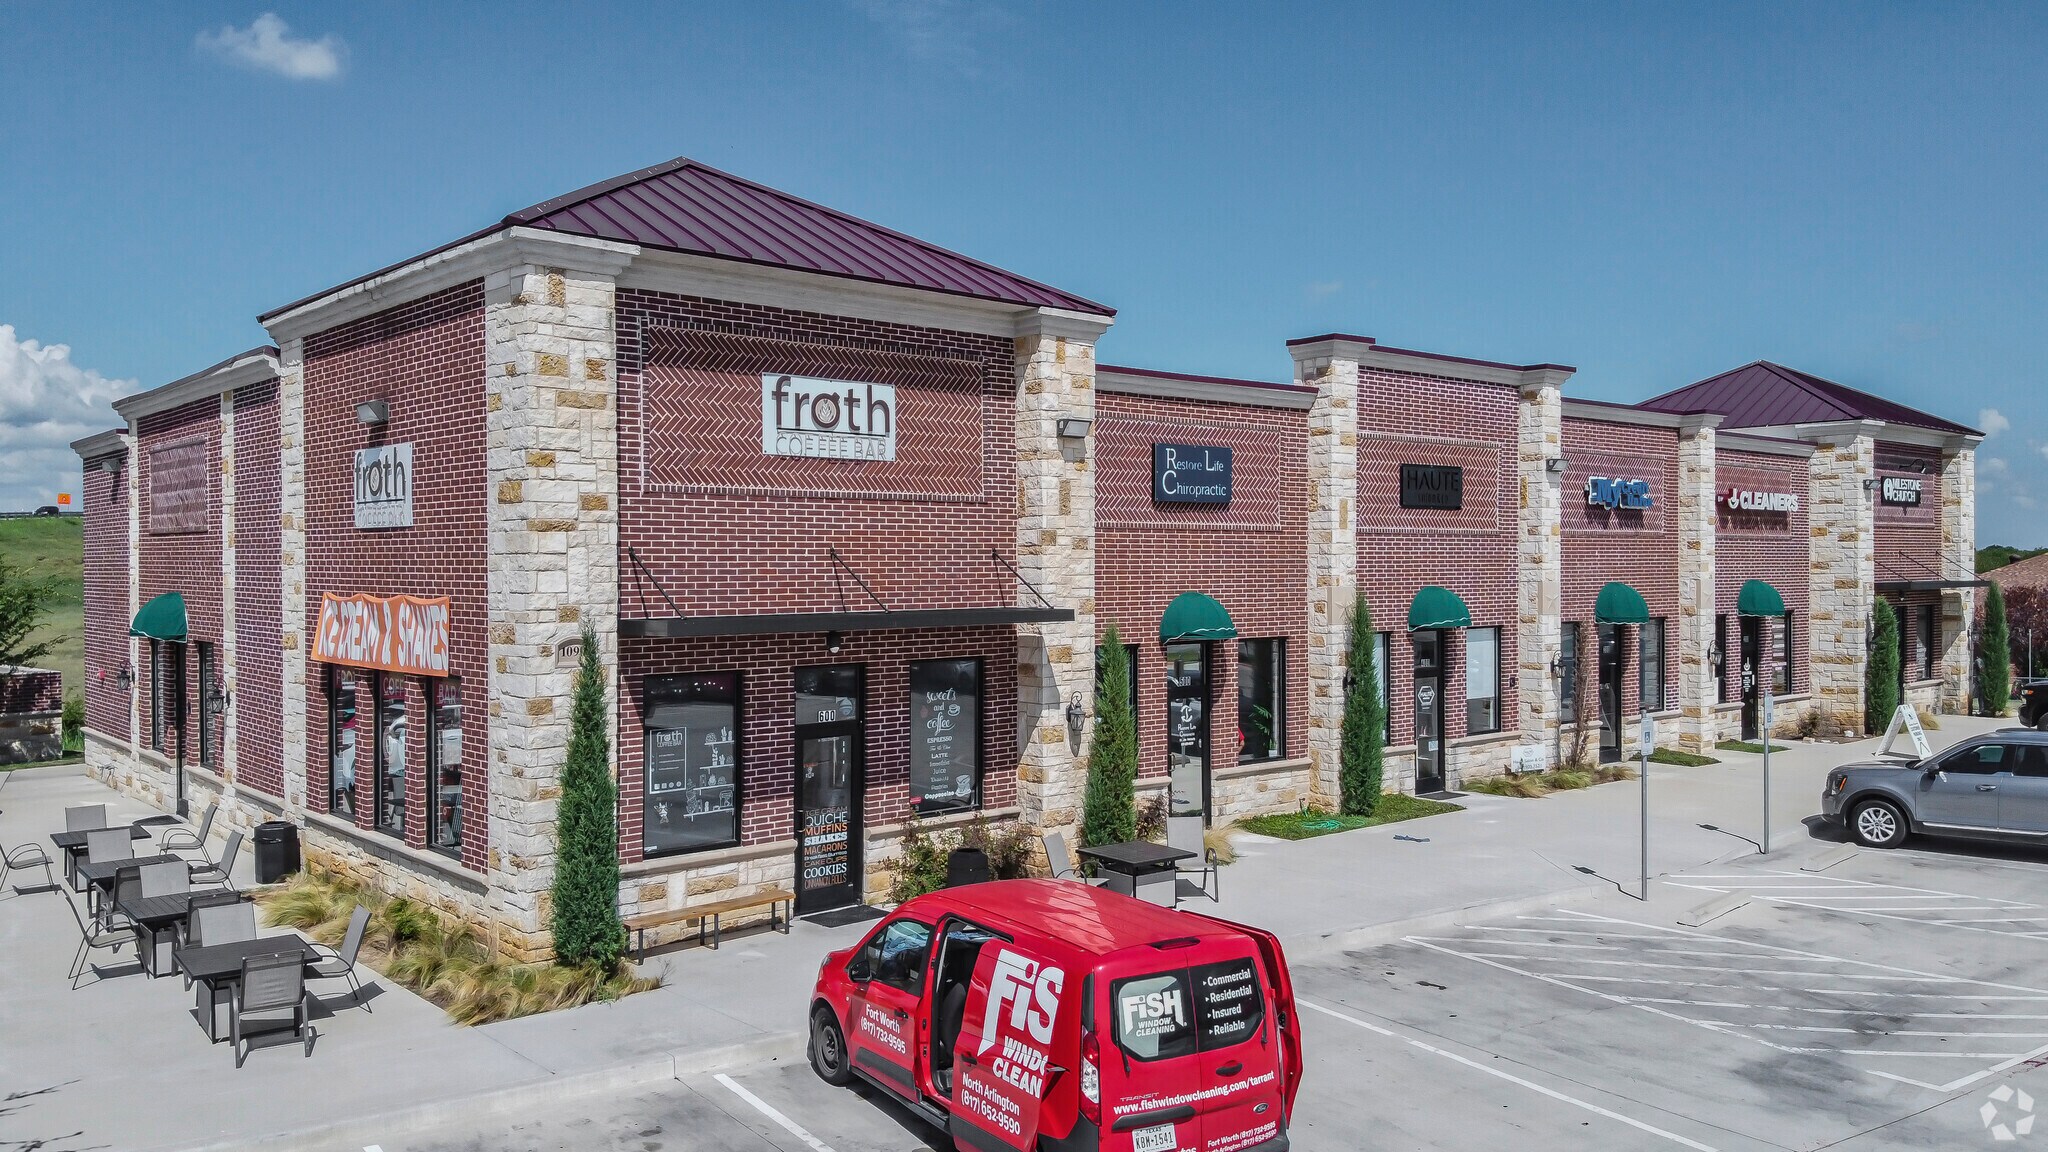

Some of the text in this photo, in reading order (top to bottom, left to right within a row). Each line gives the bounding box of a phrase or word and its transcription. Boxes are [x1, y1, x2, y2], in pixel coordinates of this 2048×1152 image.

[771, 376, 890, 434] froth
[775, 432, 887, 460] COFFEE BAR
[1165, 448, 1224, 471] Restore Life
[355, 447, 406, 500] froth
[1407, 470, 1459, 491] HAUTE
[1162, 470, 1227, 497] Chiropractic
[1594, 478, 1621, 508] My
[1892, 478, 1921, 490] MILESTONE
[1740, 491, 1799, 511] CLEANERS
[1892, 490, 1916, 502] CHURCH
[318, 599, 448, 671] ICE CREAM & SHAKES
[562, 646, 583, 657] 109
[926, 688, 957, 703] sweets
[819, 710, 836, 722] 600
[933, 702, 945, 711] and
[927, 712, 956, 736] coffee
[656, 730, 683, 743] froth
[805, 811, 848, 827] QUICHE
[804, 823, 848, 836] MUFFINS
[804, 832, 848, 847] SHAKES
[804, 842, 848, 855] MACARONS
[804, 858, 826, 867] CAKE
[804, 863, 847, 878] COOKIES
[1207, 969, 1251, 987] Commercial
[1210, 985, 1252, 1004] Residential
[866, 1003, 900, 1034] Fort Worth
[1212, 1004, 1242, 1019] Insured
[861, 1016, 906, 1054] (817) 732-9595
[1136, 1024, 1175, 1037] CLEANING
[1213, 1020, 1245, 1036] Reliable
[993, 1057, 1043, 1099] CLEAN
[962, 1072, 1020, 1116] North Arlington
[1113, 1070, 1275, 1115] www.fishwindowcleaning.com/tarrant
[1119, 1092, 1160, 1102] TRANSIT
[961, 1089, 1021, 1135] (817) 652-9590
[1207, 1121, 1276, 1148] Fort Worth (817) 732-9595
[1241, 1137, 1255, 1148] (817)
[1254, 1129, 1277, 1142] 652-9590
